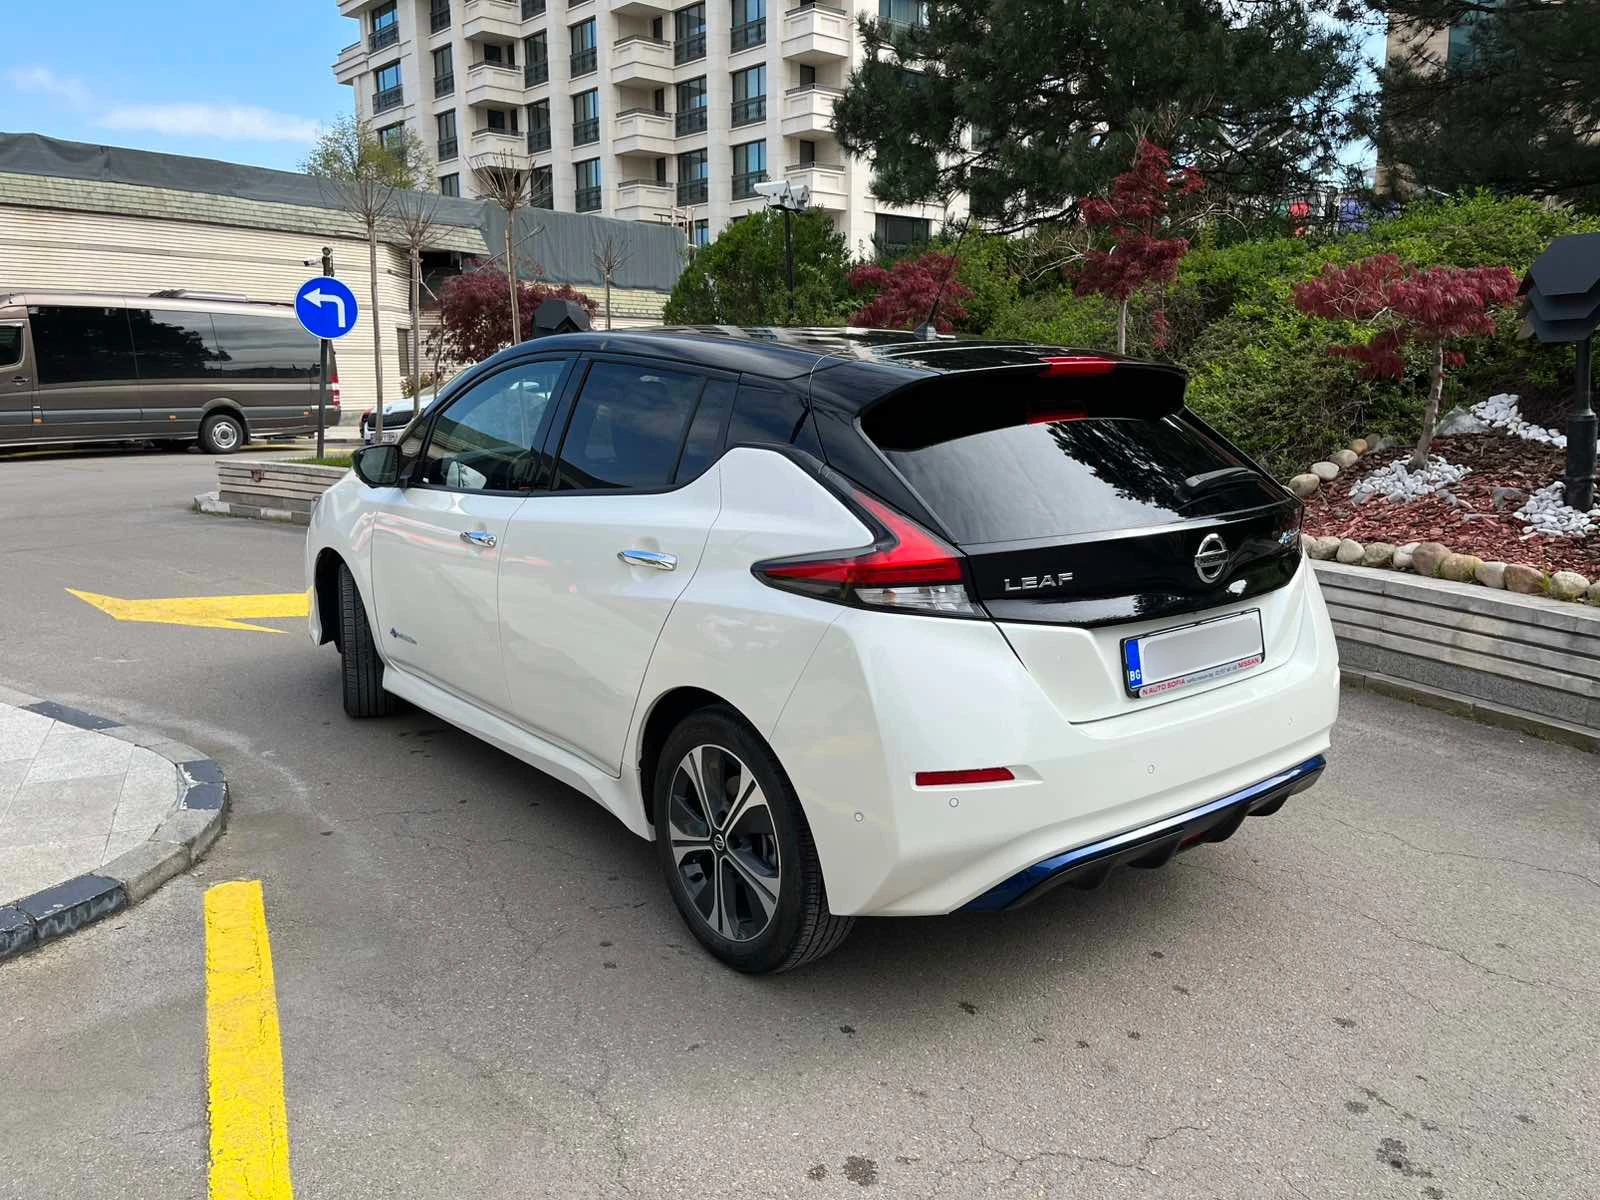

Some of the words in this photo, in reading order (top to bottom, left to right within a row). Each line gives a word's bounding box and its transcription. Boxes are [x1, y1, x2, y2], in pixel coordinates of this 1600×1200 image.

[1004, 572, 1073, 591] LEAF
[1129, 669, 1141, 681] BG
[1148, 684, 1166, 694] AUTO
[1167, 678, 1185, 688] SOFIA
